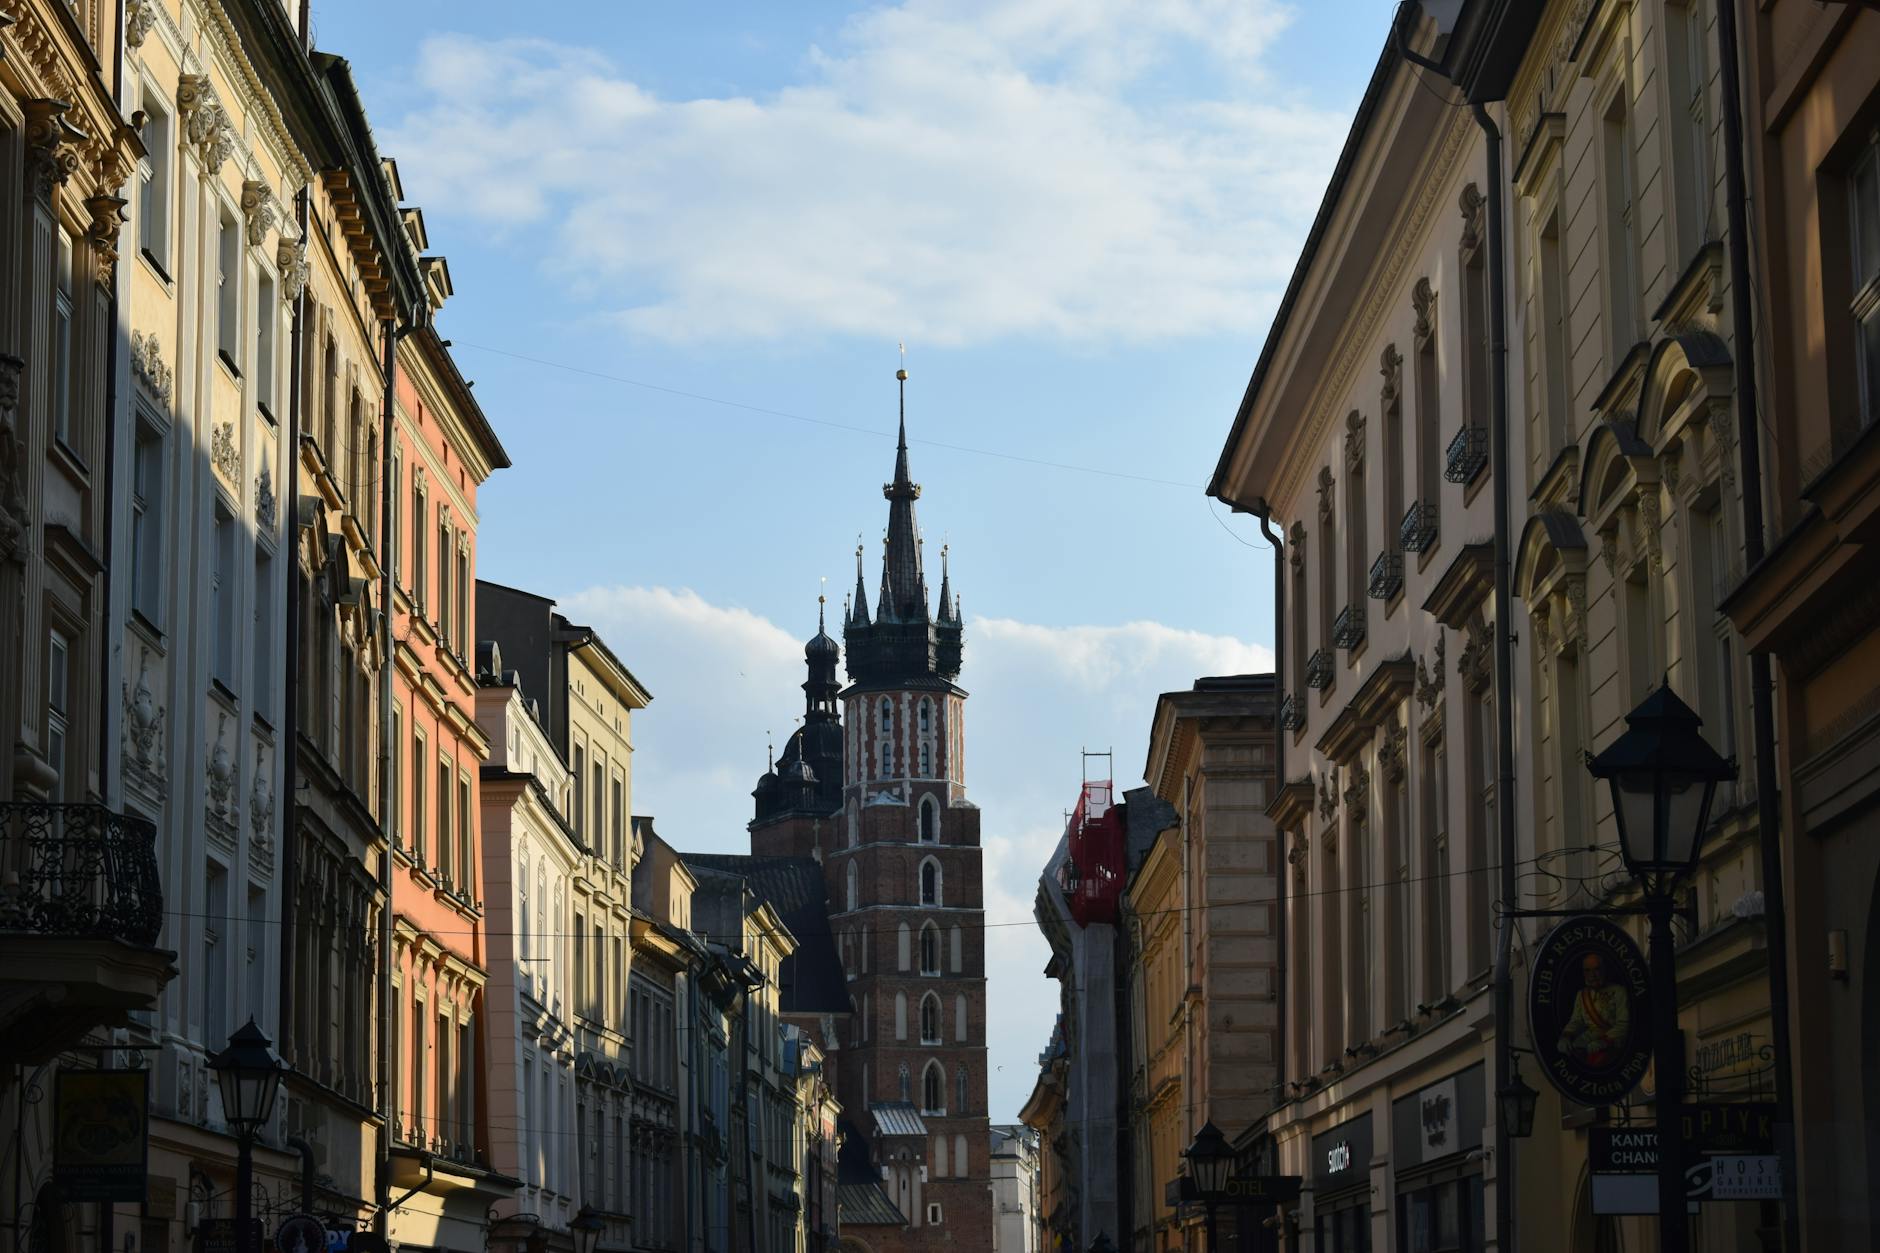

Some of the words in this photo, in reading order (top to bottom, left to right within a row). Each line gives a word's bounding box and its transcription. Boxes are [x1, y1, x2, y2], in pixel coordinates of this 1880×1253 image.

[1536, 969, 1553, 1007] PUB
[1552, 925, 1648, 998] RESTAURACJA
[1553, 1057, 1579, 1086] Pod
[1610, 1151, 1659, 1164] CHAN
[1225, 1179, 1268, 1198] OTEL
